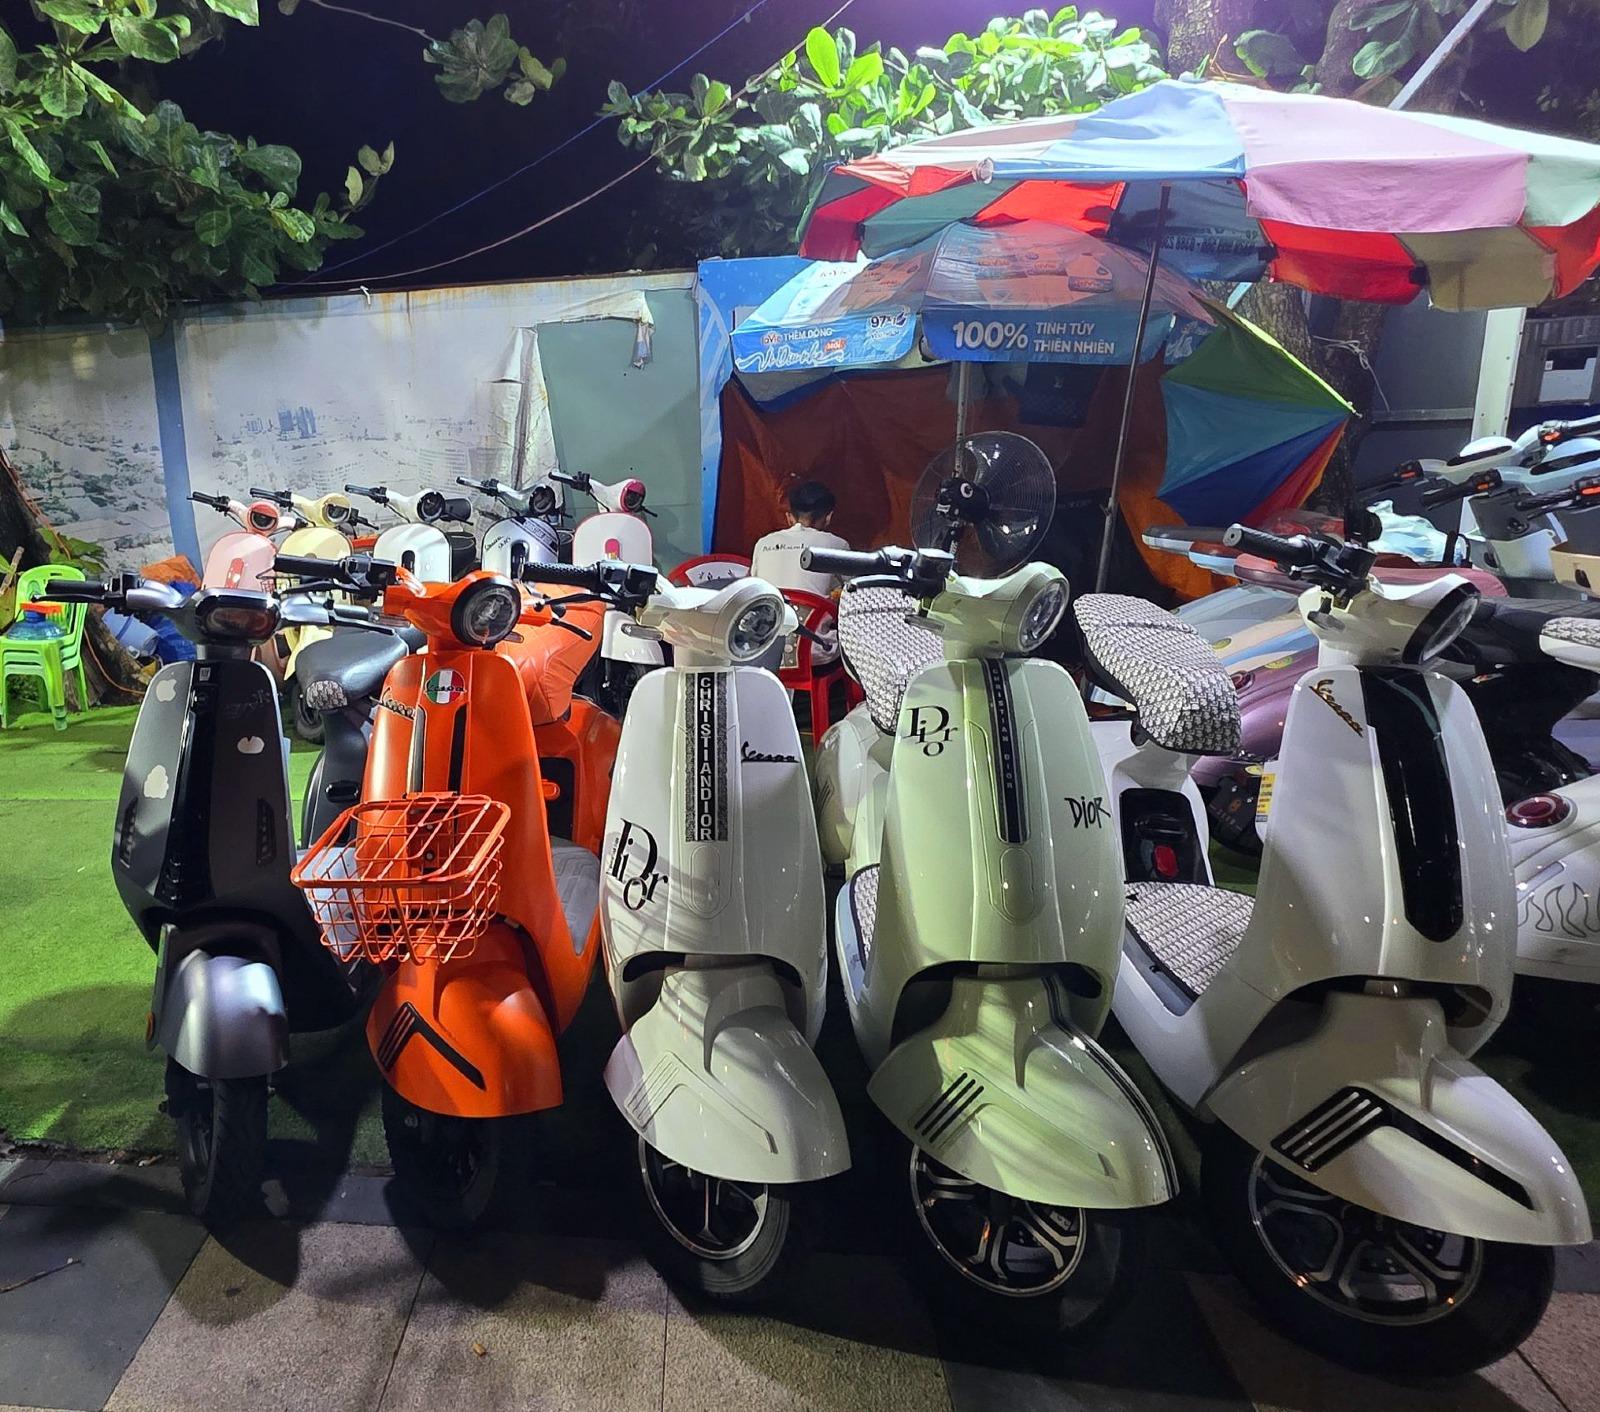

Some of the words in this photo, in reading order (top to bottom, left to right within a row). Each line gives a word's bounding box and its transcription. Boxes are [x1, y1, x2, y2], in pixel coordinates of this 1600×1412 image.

[952, 321, 1029, 349] 100%
[1036, 322, 1067, 335] TINH
[1034, 338, 1071, 353] THIÊN
[1073, 338, 1115, 354] NHIÊN
[903, 705, 958, 757] Dior
[741, 741, 800, 763] Vespa
[1004, 754, 1014, 789] DIOR
[606, 817, 669, 911] Dior
